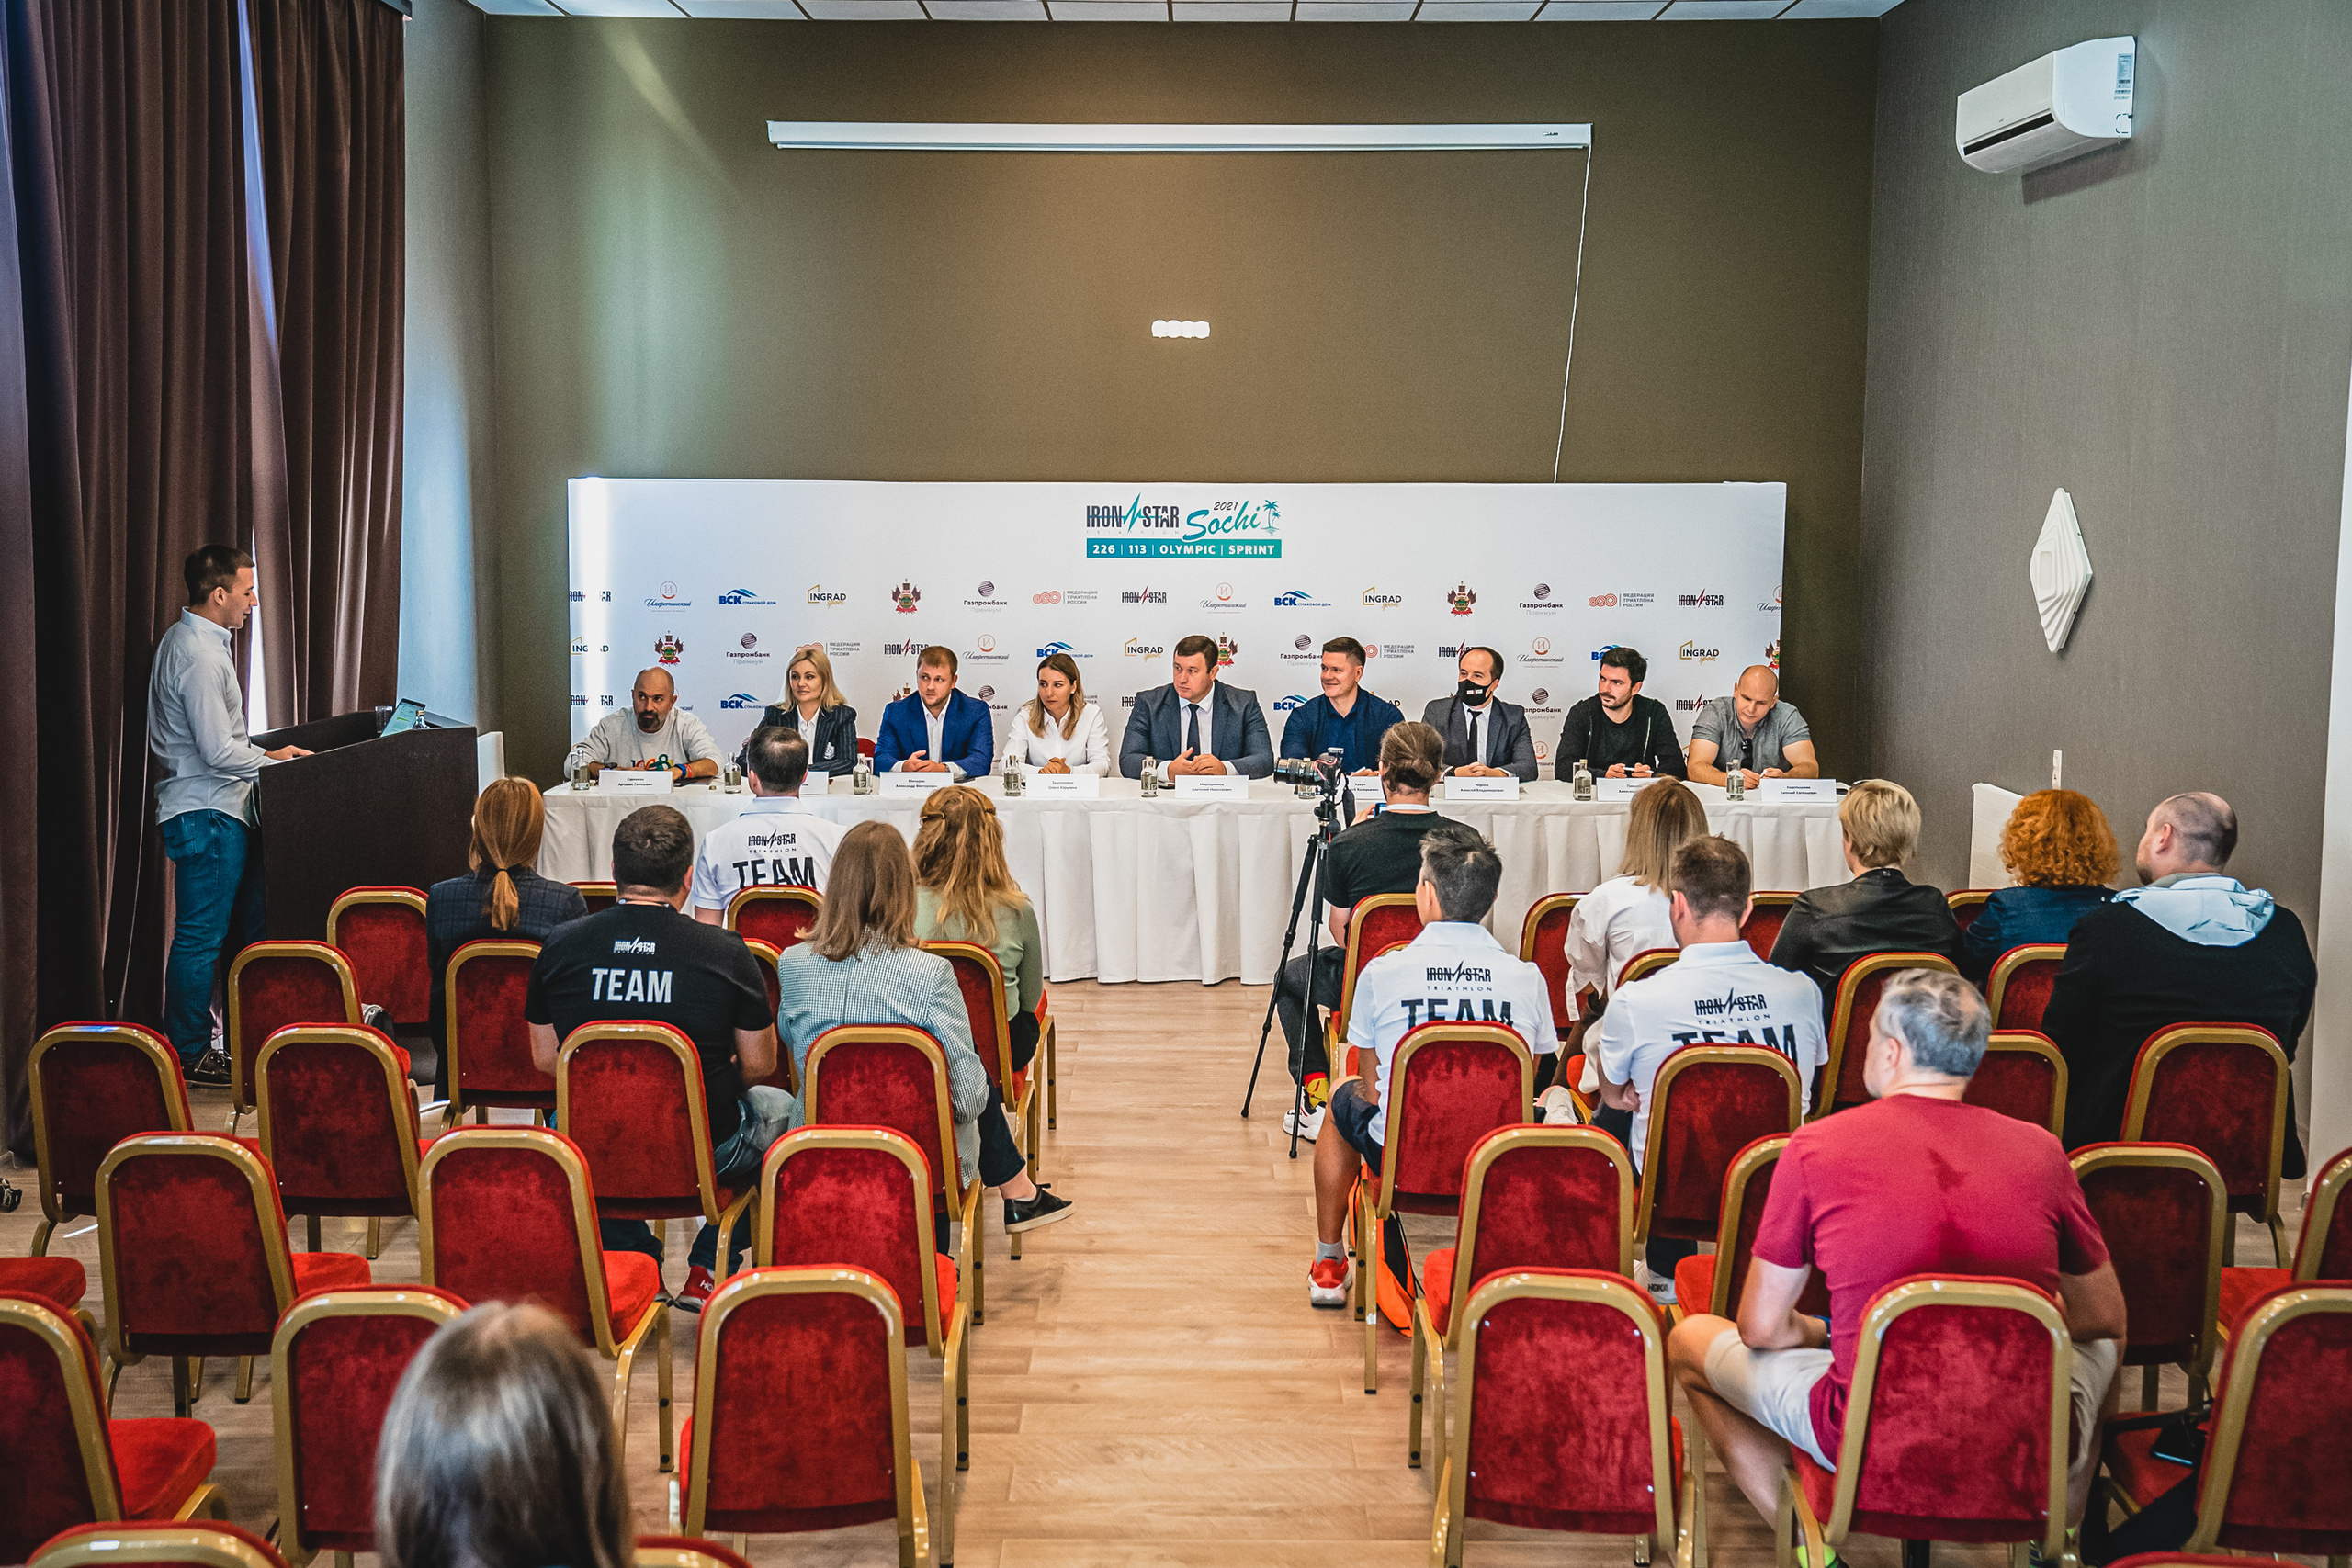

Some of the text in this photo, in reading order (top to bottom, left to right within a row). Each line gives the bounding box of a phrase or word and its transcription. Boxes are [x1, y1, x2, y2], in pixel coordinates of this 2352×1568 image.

[1213, 502, 1238, 511] 2021
[1087, 500, 1261, 541] IRON STAR Sochi
[1092, 544, 1275, 556] 226 113 OLYMPIC SPRINT
[569, 591, 583, 603] RON
[718, 595, 742, 605] ВСК
[809, 592, 847, 601] INGRAD
[1122, 592, 1167, 604] IRON STAR
[1274, 597, 1297, 606] ВСК
[1364, 595, 1402, 604] INGRAD
[1678, 594, 1724, 606] IRON STAR
[963, 599, 1008, 607] Газпромбанк
[1519, 602, 1564, 610] Газпромбанк
[572, 644, 609, 652] INGD
[884, 643, 902, 655] IRON
[1126, 646, 1164, 654] INGRAD
[1438, 646, 1456, 658] IRON
[1682, 649, 1720, 657] INGRAD
[570, 694, 614, 706] RON TAR
[720, 700, 744, 709] ВСК
[1122, 696, 1136, 707] IRO
[1676, 699, 1694, 711] IRON
[1426, 967, 1492, 983] IRON STAR
[592, 967, 673, 1003] TEAM
[1694, 993, 1768, 1016] IRON STAR
[1698, 1013, 1771, 1026] TRIATHLON
